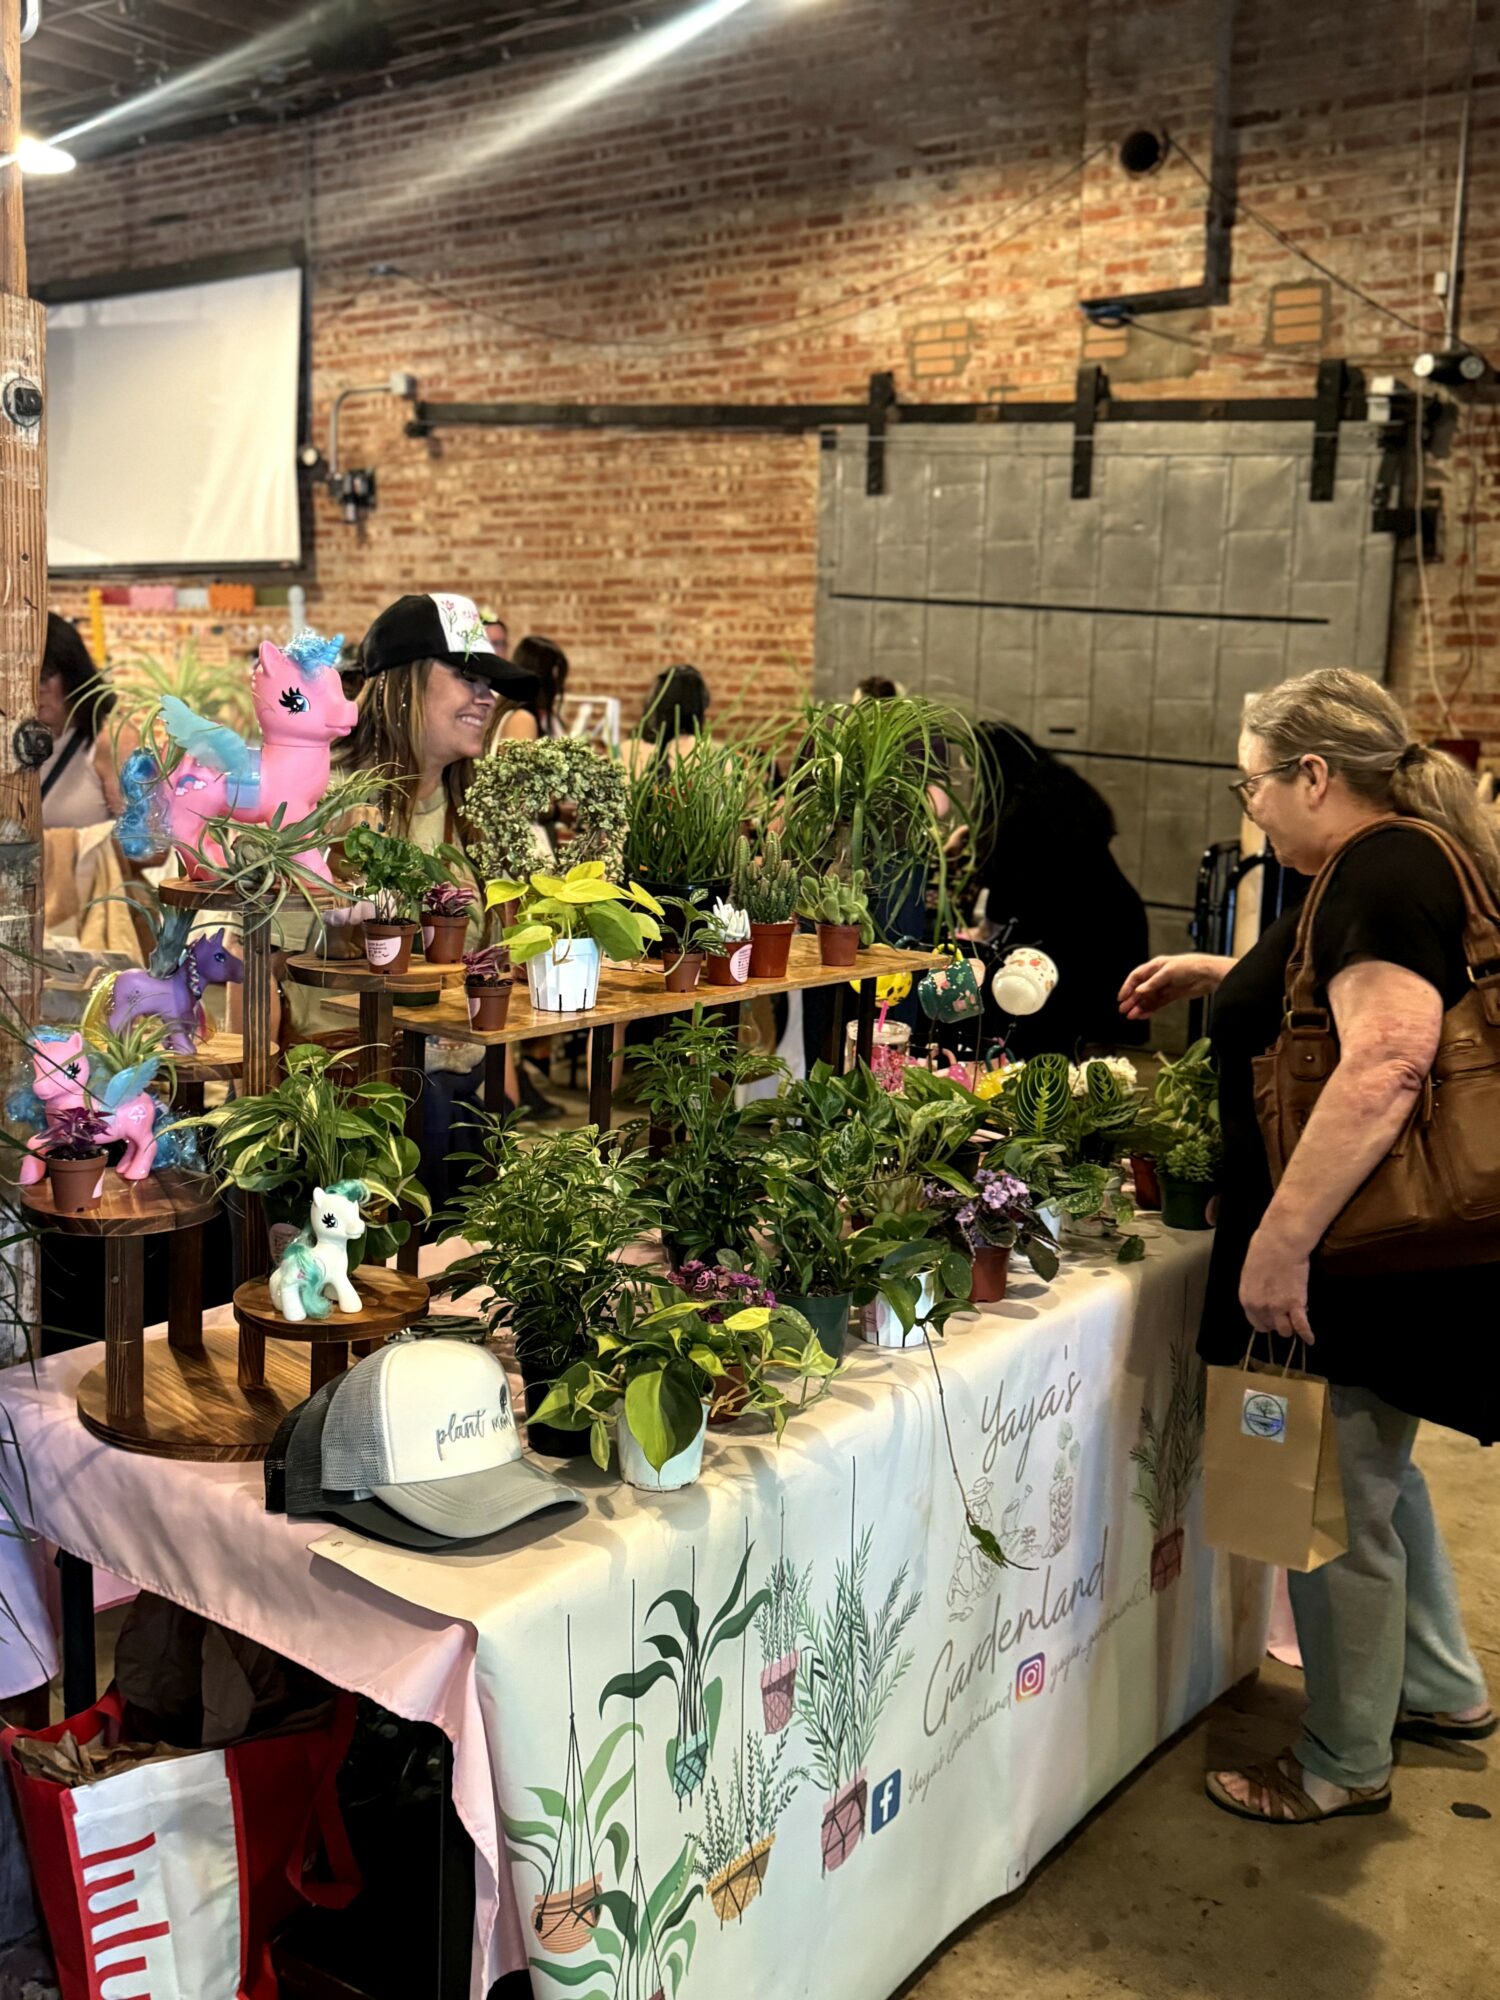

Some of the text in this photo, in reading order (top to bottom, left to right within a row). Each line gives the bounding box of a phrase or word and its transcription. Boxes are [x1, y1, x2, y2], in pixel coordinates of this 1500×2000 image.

[436, 1409, 487, 1461] plant
[982, 1344, 1082, 1483] Yaya's
[922, 1526, 1108, 1737] Gardenland
